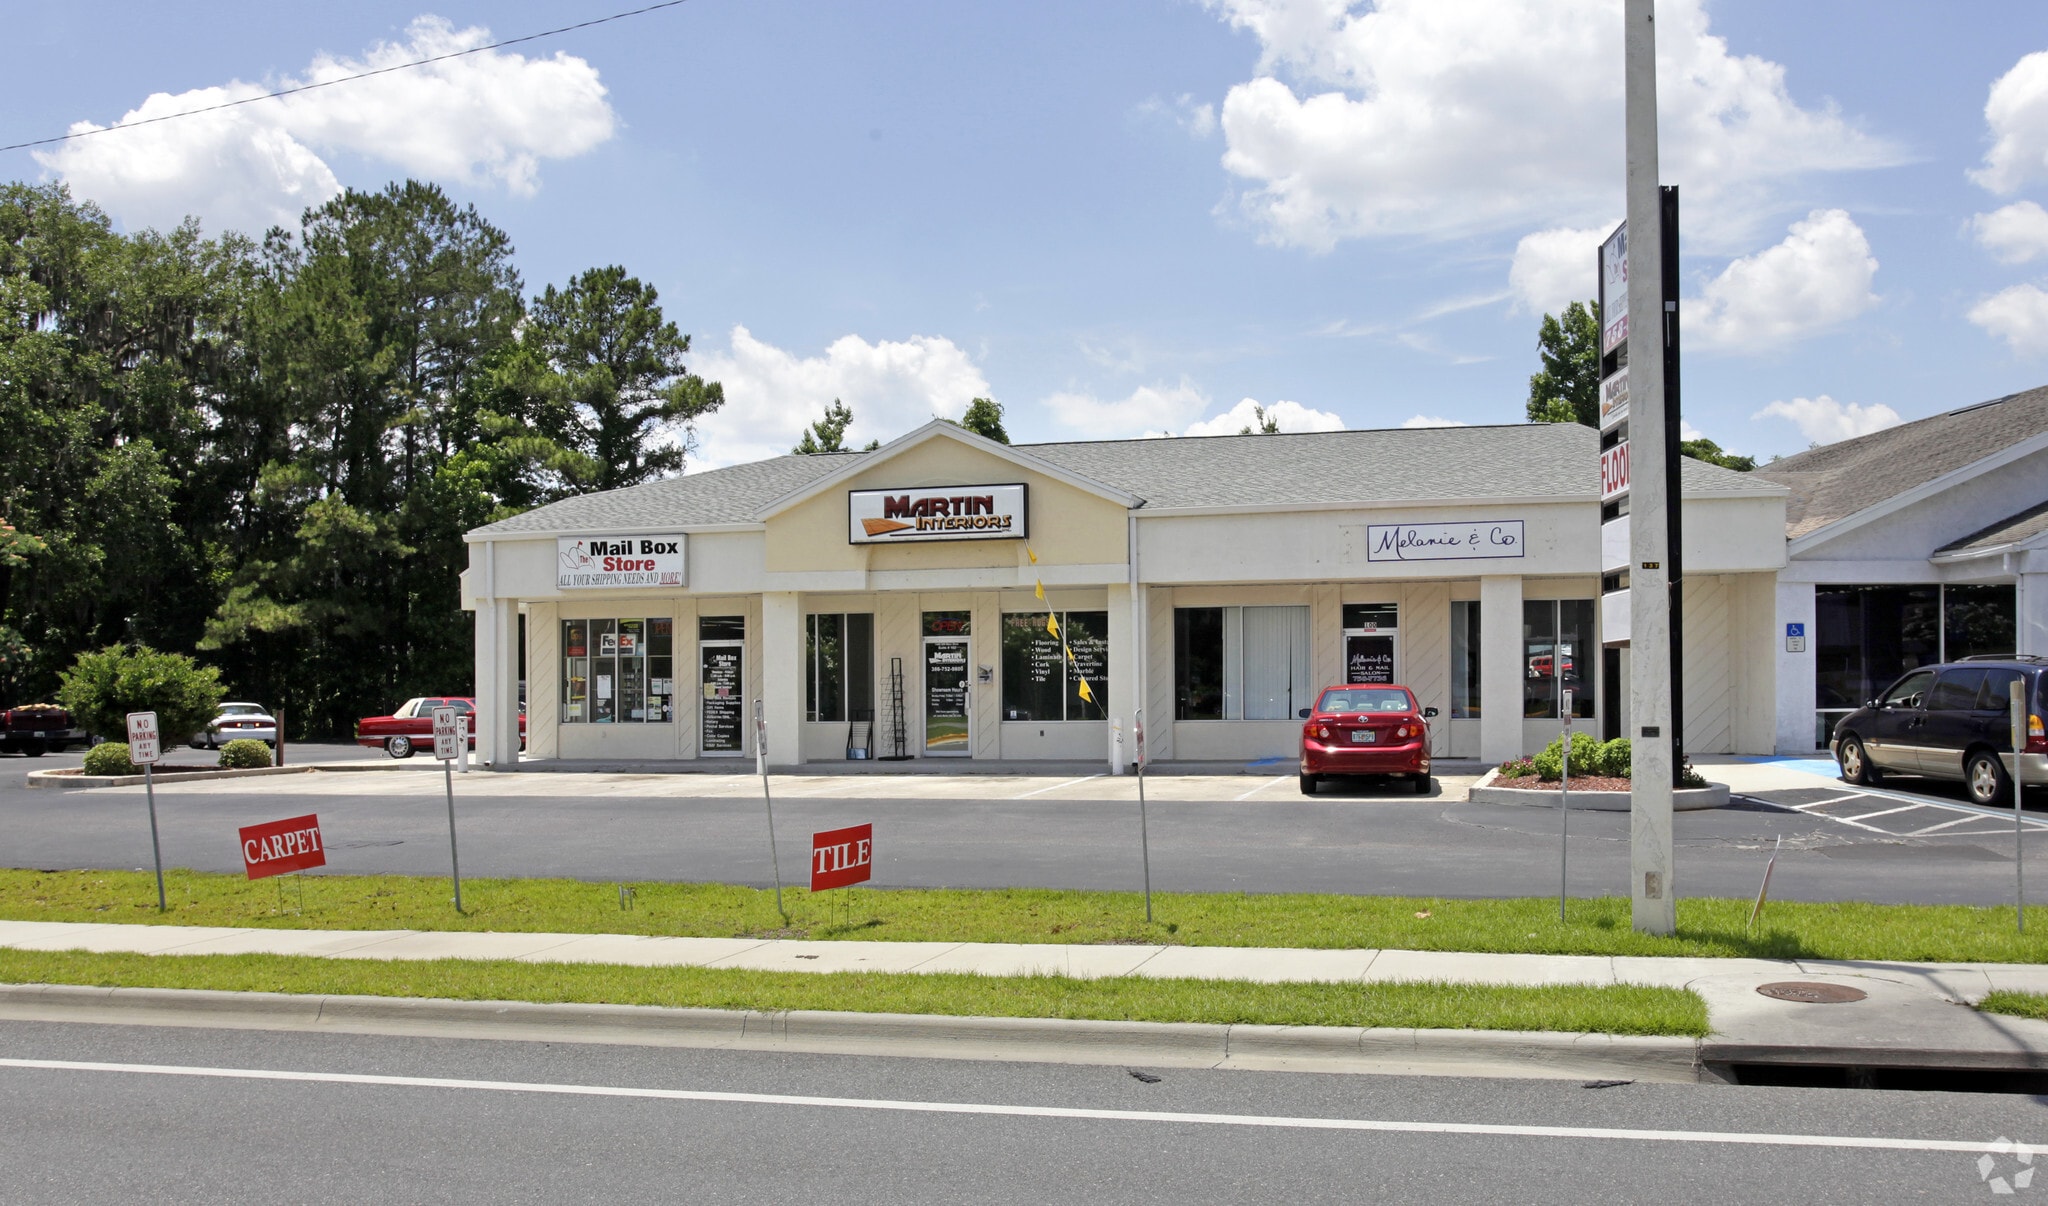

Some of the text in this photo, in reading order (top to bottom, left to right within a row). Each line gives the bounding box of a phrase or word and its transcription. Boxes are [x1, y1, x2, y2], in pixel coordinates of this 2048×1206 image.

[884, 495, 993, 519] MARTIN
[915, 514, 1012, 531] INTERIORS
[590, 540, 678, 556] Mail Box
[1373, 526, 1461, 560] Melanie
[579, 555, 589, 563] The
[603, 556, 655, 572] Store
[559, 574, 571, 586] ALL
[572, 574, 590, 586] YOUR
[591, 573, 620, 586] SHIPPING
[622, 573, 645, 585] NEEDS
[645, 572, 659, 584] AND
[934, 652, 961, 660] MARTIN
[136, 719, 149, 729] NO
[439, 713, 450, 724] NO
[131, 730, 157, 741] PARKING
[435, 726, 456, 736] PARKING
[138, 750, 153, 758] TIME
[441, 746, 453, 754] TIME
[244, 827, 320, 865] CARPET
[813, 838, 871, 874] TILE
